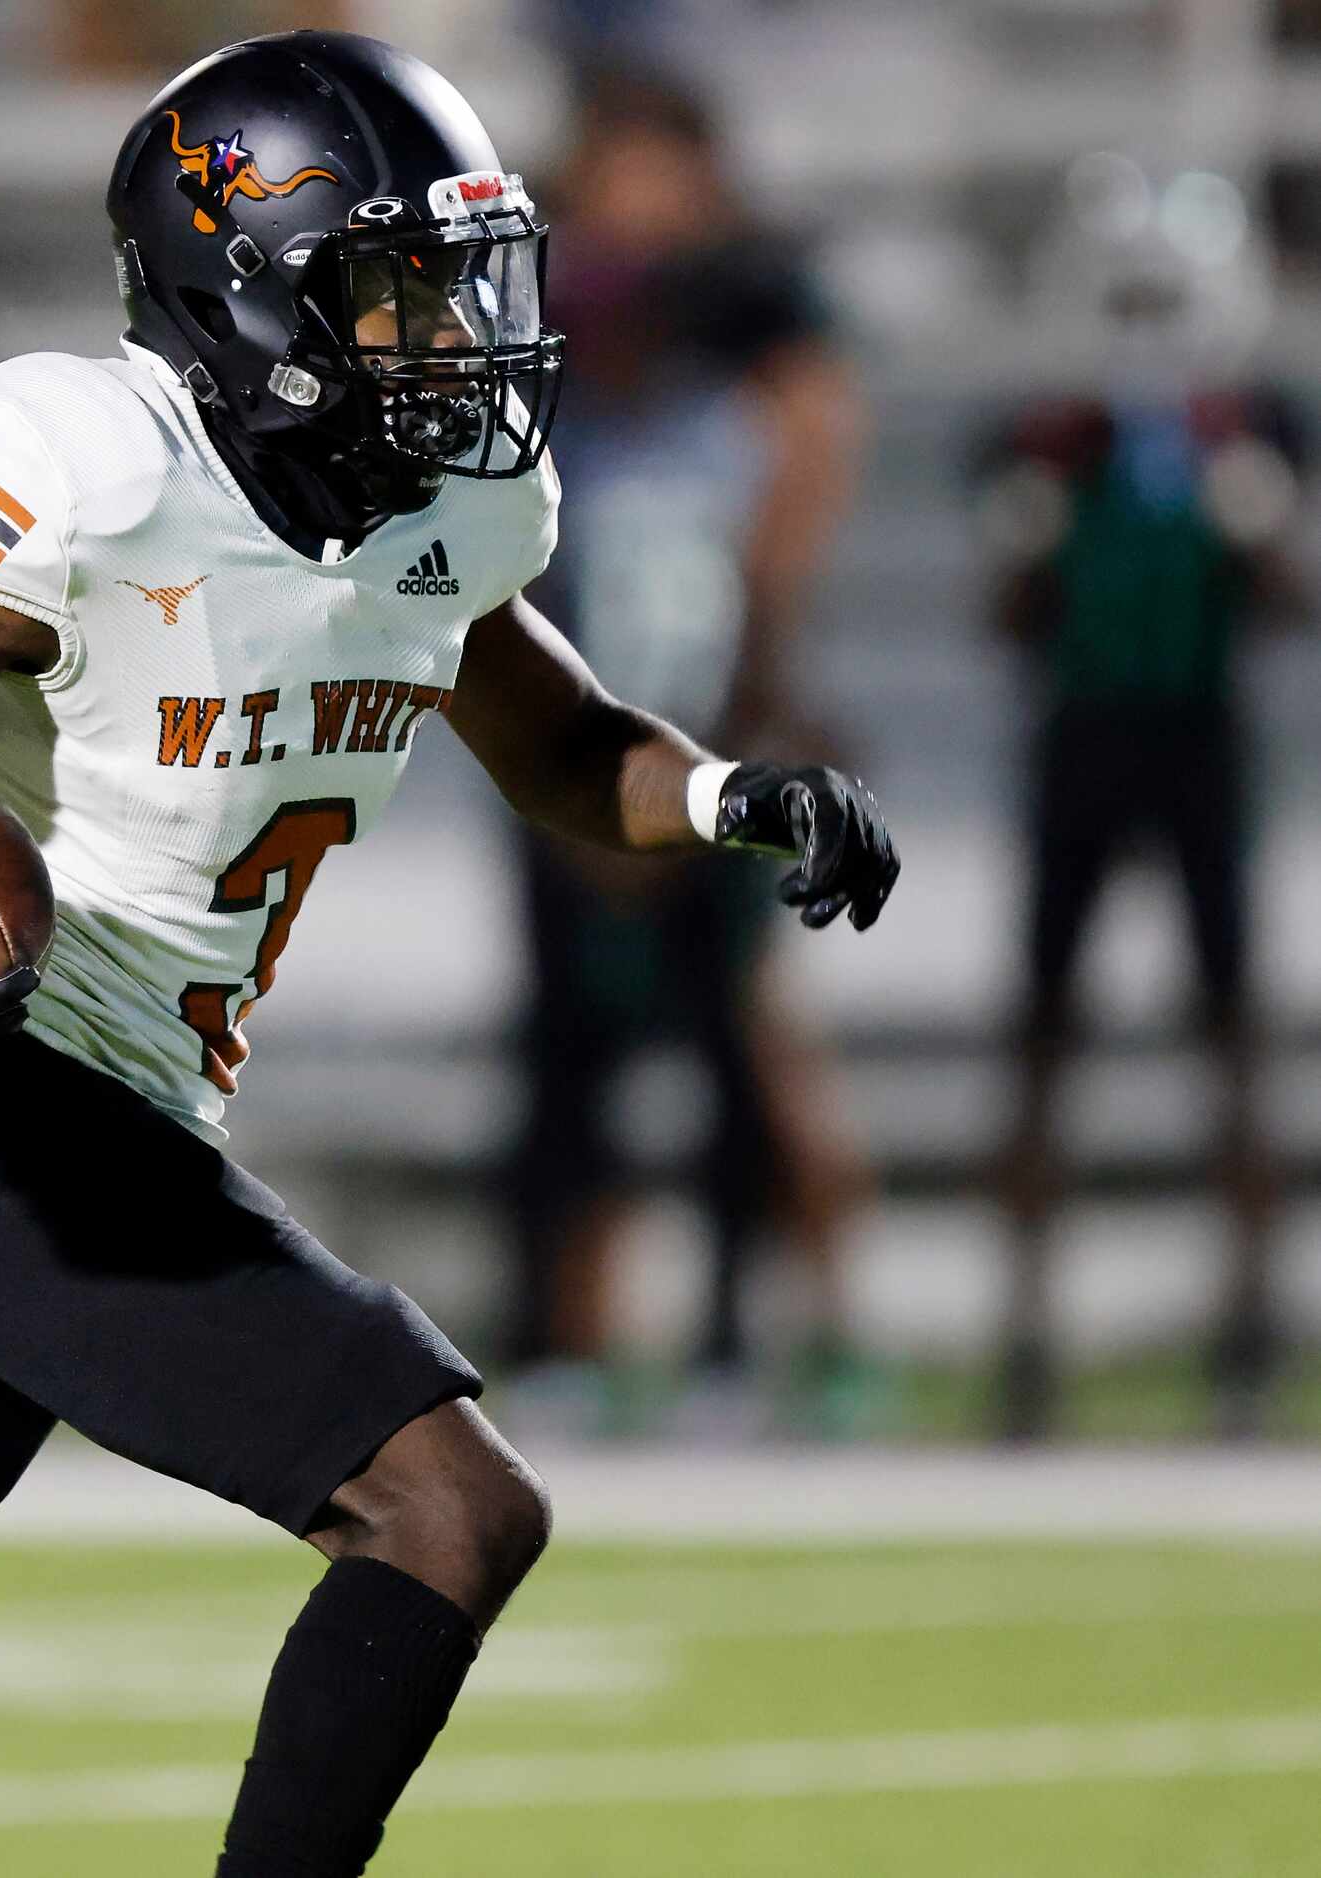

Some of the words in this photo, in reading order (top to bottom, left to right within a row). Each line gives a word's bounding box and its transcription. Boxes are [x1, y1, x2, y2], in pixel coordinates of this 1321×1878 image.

[397, 574, 460, 596] adidas
[311, 678, 454, 756] WHIT
[178, 797, 357, 1096] 3
